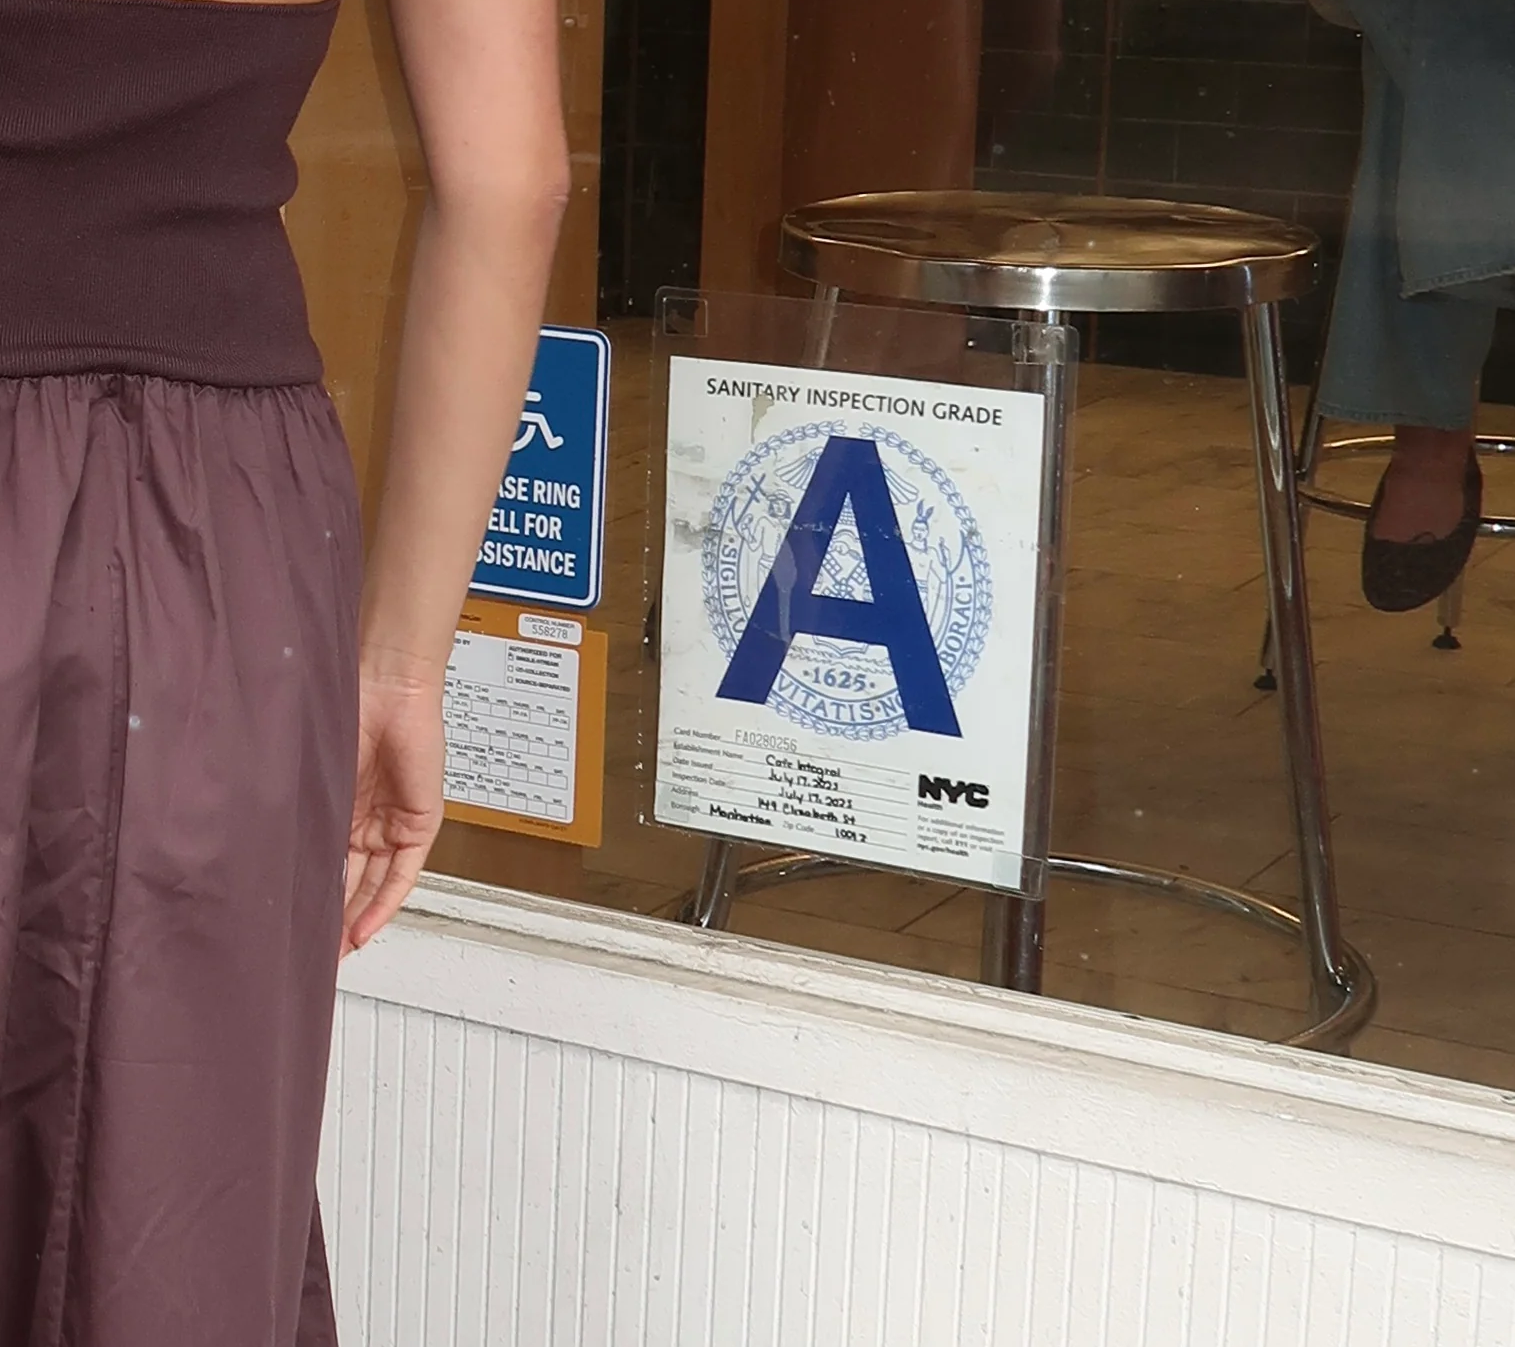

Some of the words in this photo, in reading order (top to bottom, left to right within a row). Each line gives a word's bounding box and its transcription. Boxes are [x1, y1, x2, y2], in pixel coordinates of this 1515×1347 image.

[706, 377, 801, 404] SANITARY
[806, 388, 925, 417] INSPECTION
[932, 402, 1003, 426] GRADE
[533, 479, 581, 508] RING
[488, 508, 520, 534] ELL
[525, 513, 562, 541] FOR
[477, 540, 576, 577] SISTANCE
[715, 435, 963, 738] A
[812, 666, 866, 693] 1625
[673, 727, 690, 736] Card
[692, 730, 721, 741] Number
[778, 786, 804, 805] July
[918, 774, 989, 809] NYC
